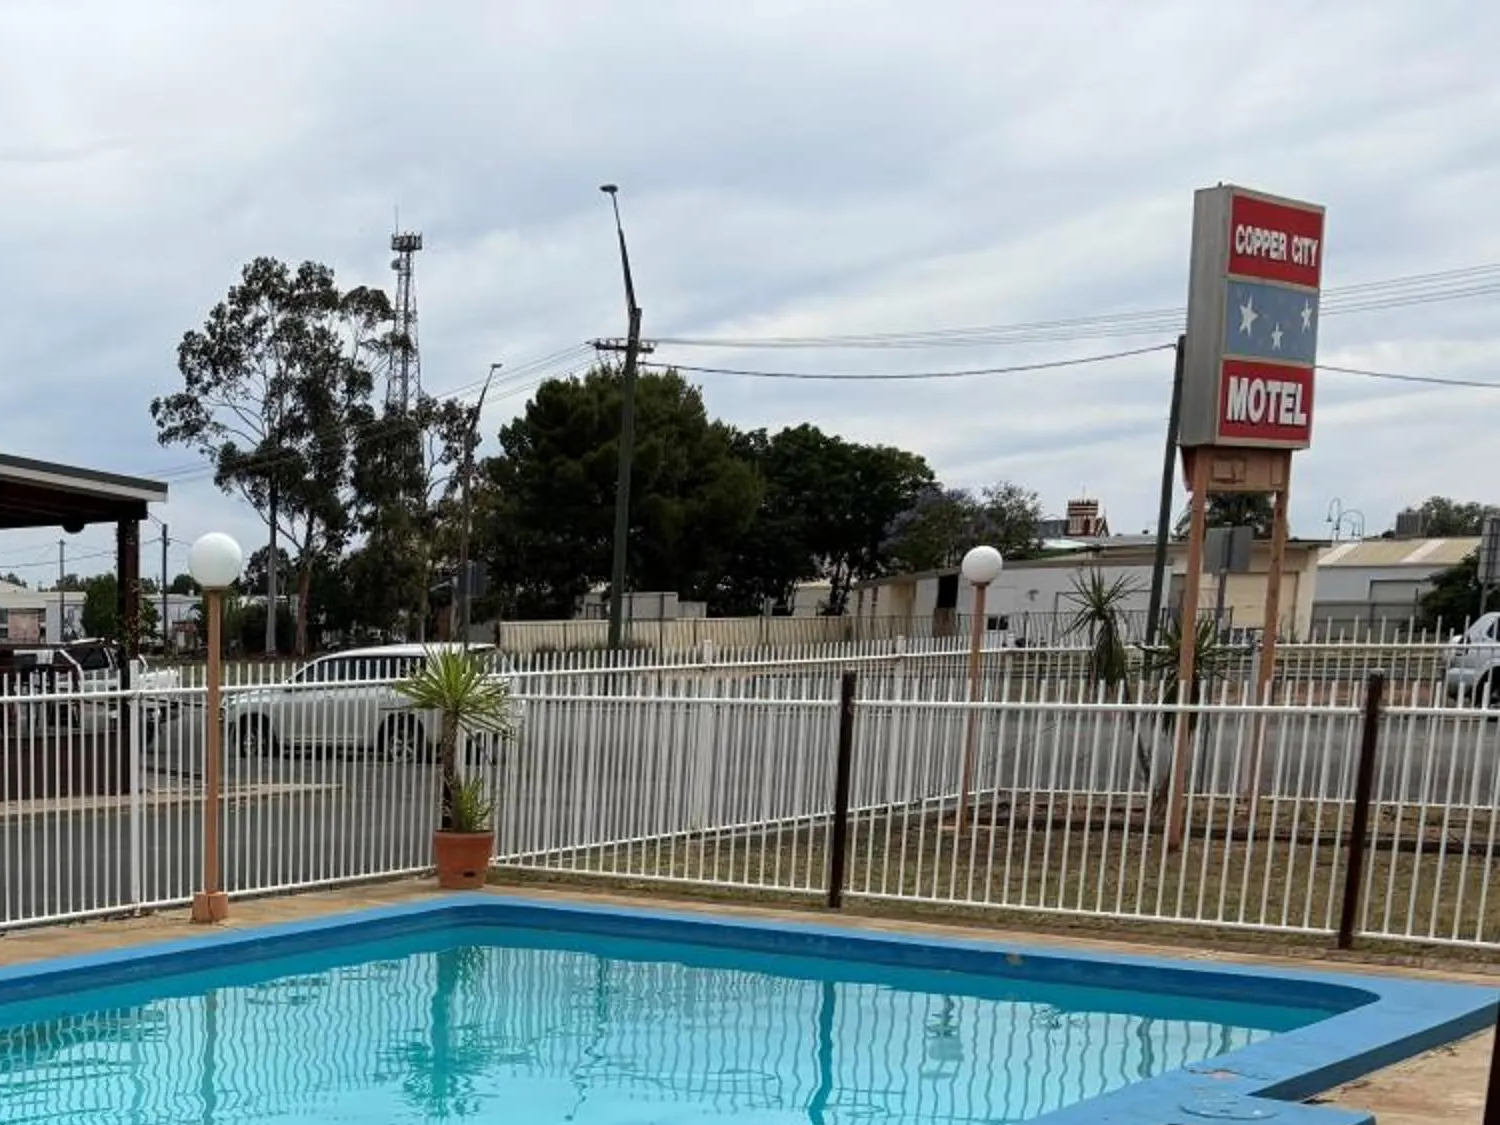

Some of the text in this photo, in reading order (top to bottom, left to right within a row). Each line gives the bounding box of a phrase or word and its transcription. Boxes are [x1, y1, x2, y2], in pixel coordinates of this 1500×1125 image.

[1235, 224, 1319, 267] COPPER CITY
[1226, 375, 1307, 425] MOTEL
